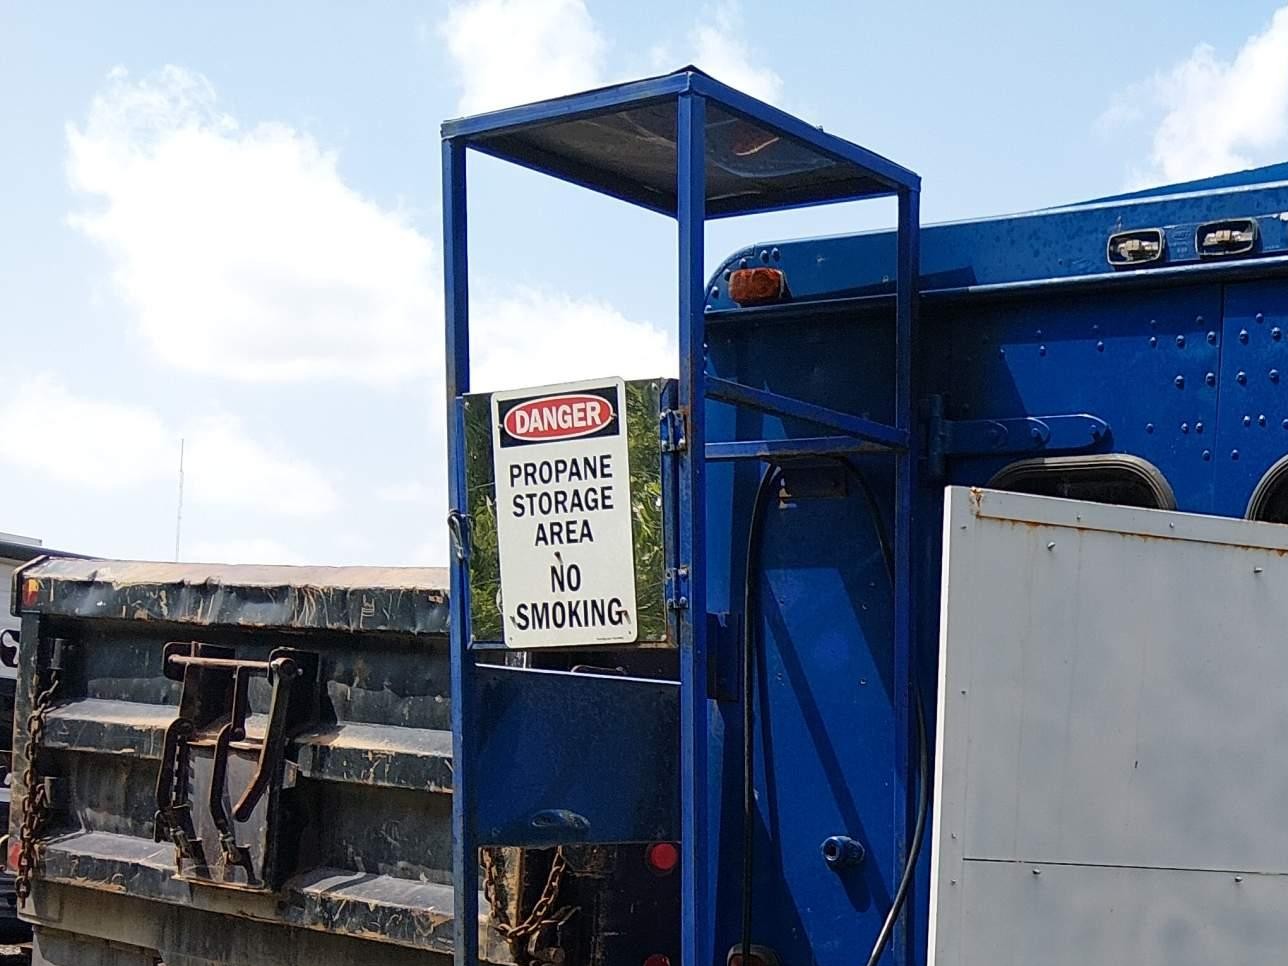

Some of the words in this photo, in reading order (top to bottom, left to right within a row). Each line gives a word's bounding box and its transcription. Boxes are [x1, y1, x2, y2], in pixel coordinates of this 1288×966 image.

[514, 401, 602, 434] DANGER
[509, 454, 613, 487] PROPANE
[512, 486, 614, 517] STORAGE
[534, 519, 594, 547] AREA
[550, 564, 582, 593] NO
[516, 598, 624, 631] SMOKING
